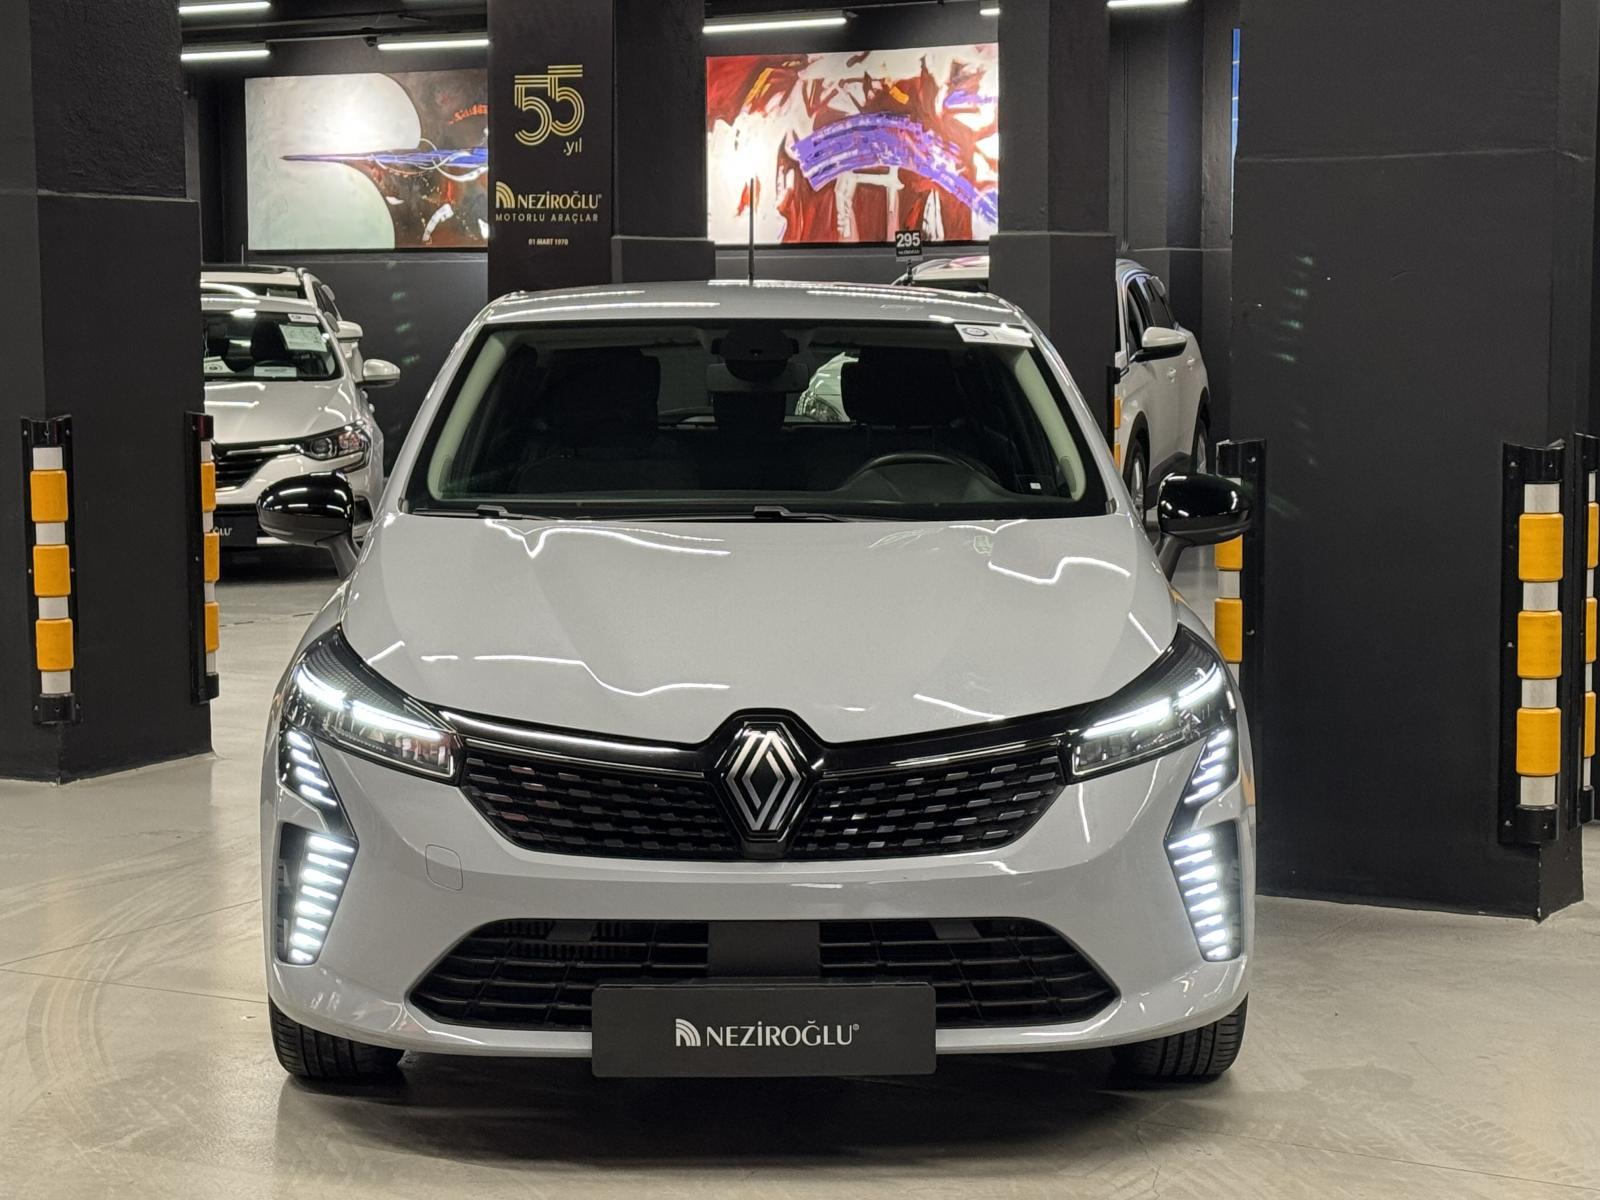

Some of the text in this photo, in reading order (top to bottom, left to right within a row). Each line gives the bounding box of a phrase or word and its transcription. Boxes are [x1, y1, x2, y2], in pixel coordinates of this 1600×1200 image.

[514, 64, 585, 146] 55
[517, 190, 599, 209] NEZİROĞLU
[495, 212, 599, 225] MOTORLU ARAÇLAR
[536, 238, 554, 246] MART
[554, 238, 569, 246] 1970
[896, 232, 921, 247] 295
[706, 1020, 853, 1047] NEZİROĞLU
